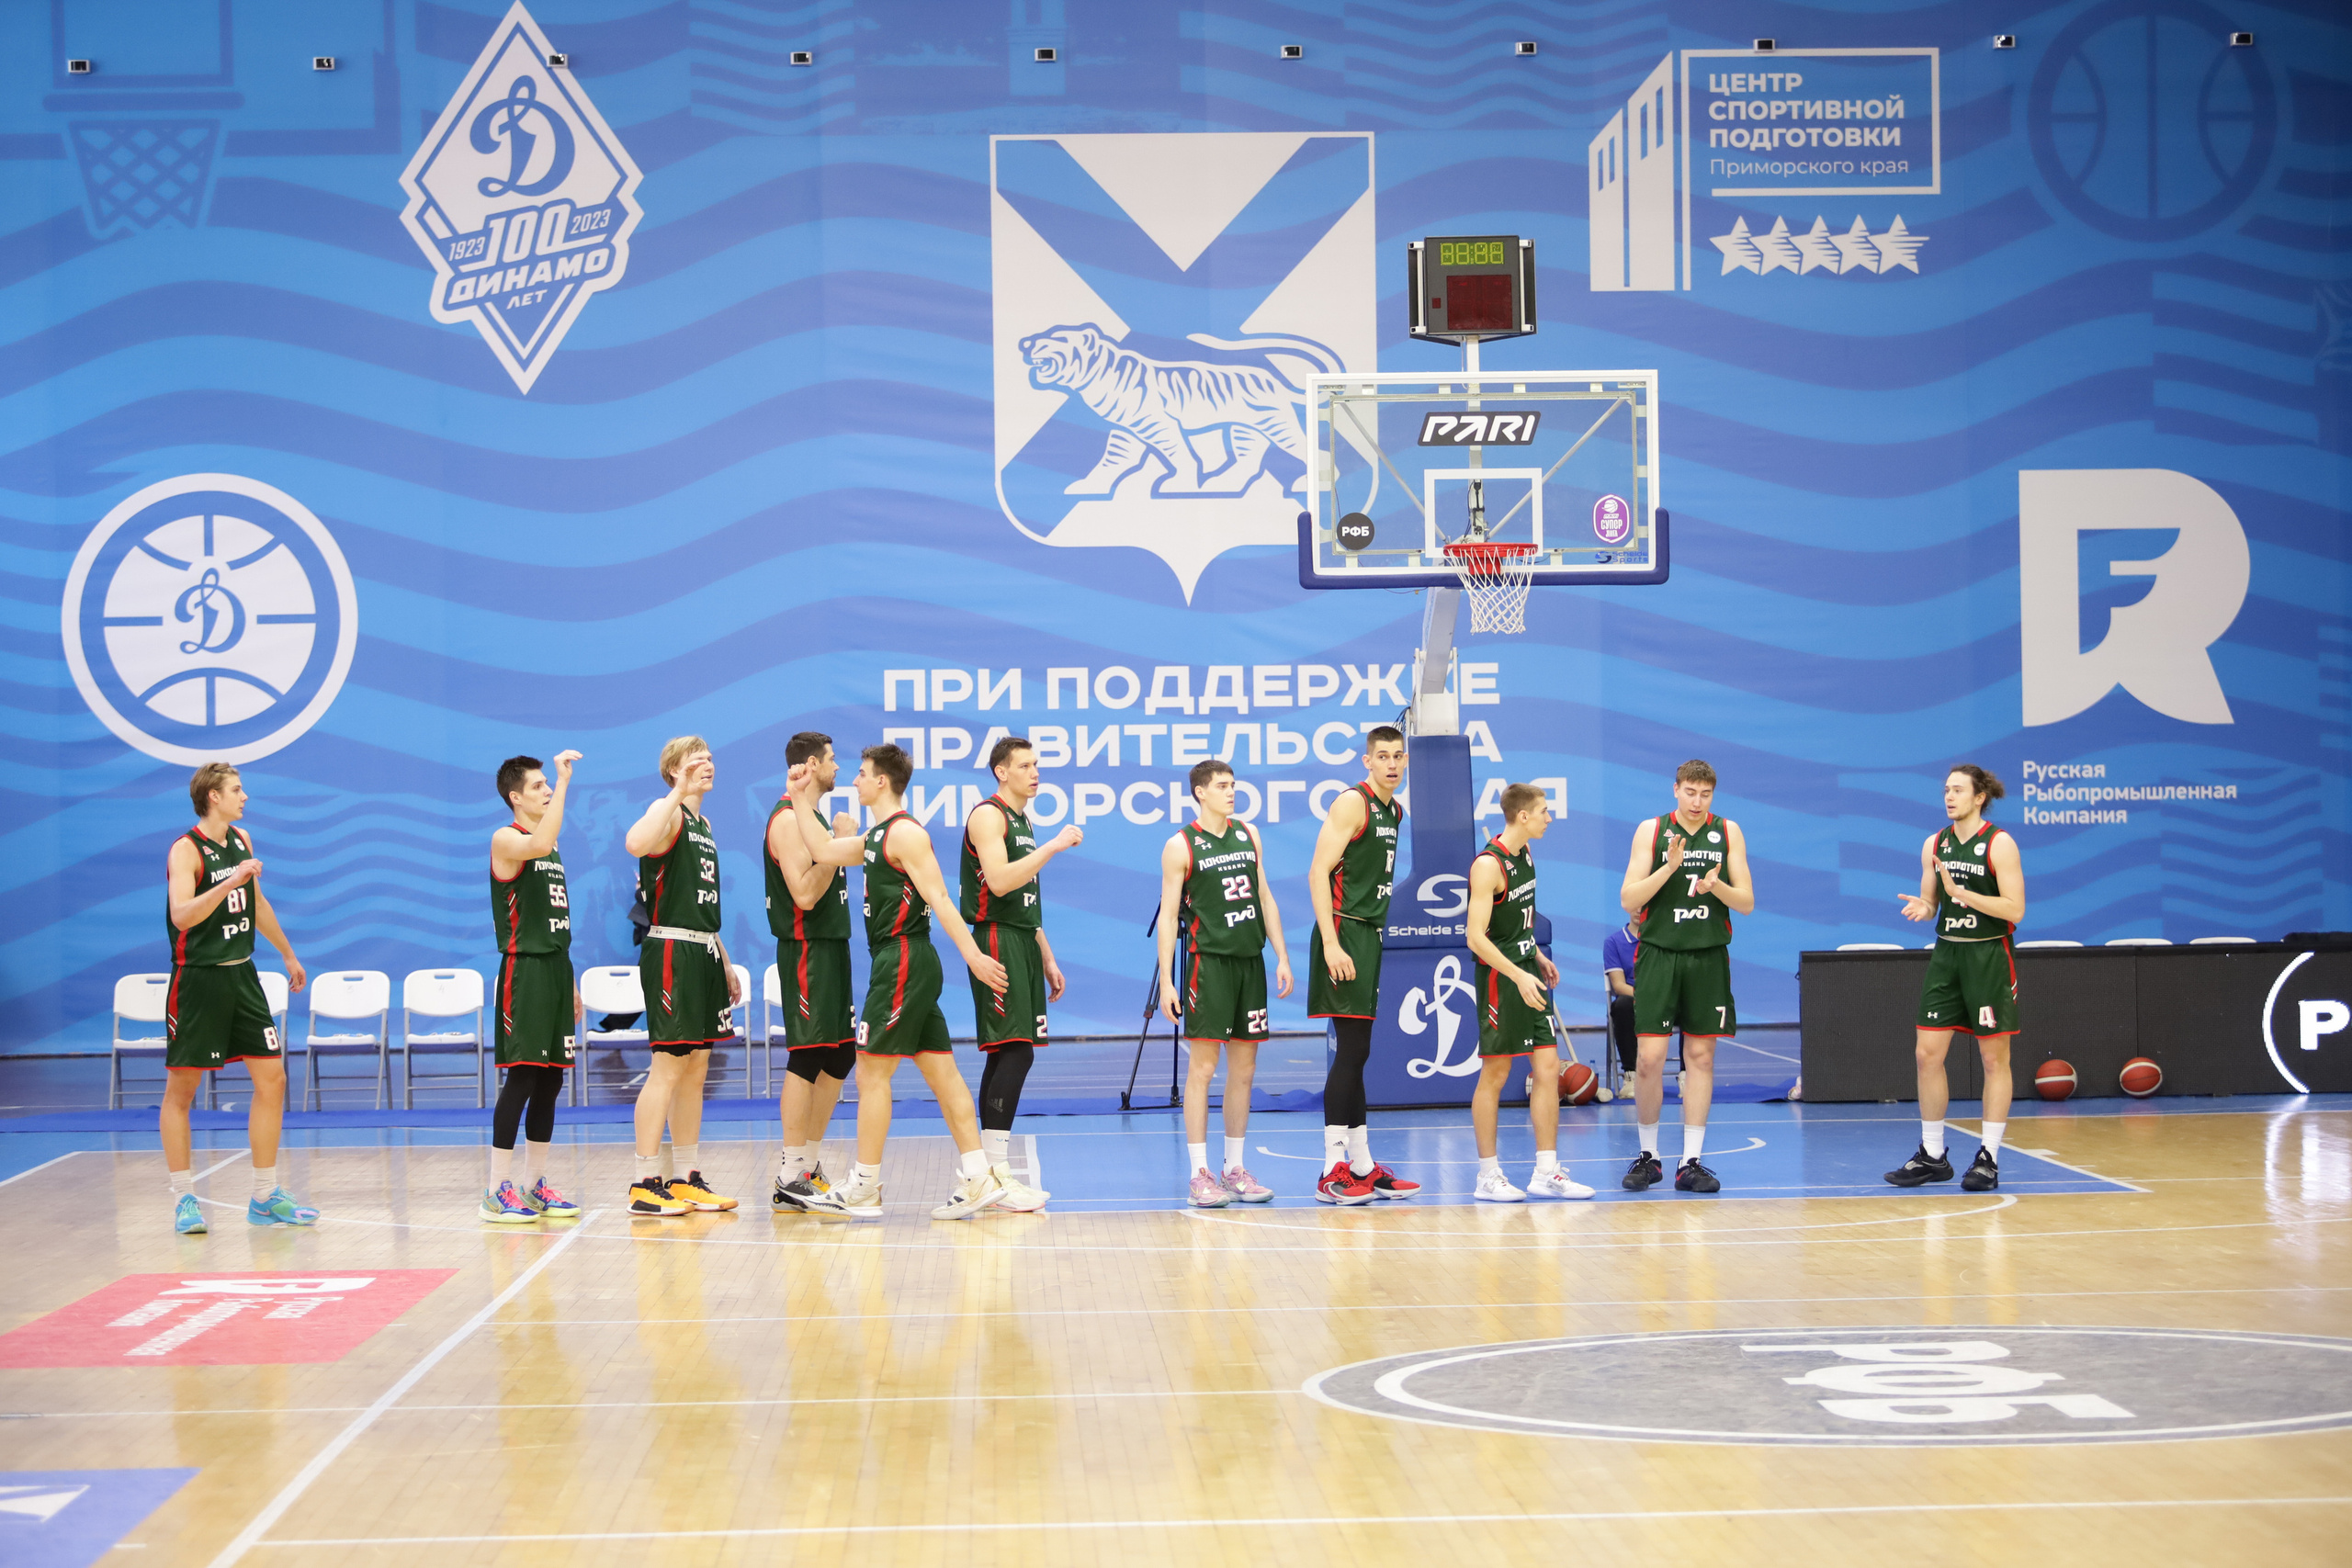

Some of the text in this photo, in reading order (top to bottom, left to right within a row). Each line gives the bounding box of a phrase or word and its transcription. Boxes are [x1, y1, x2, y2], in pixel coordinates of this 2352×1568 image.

[1709, 73, 1803, 96] ЦЕНТР
[1709, 95, 1905, 120] СПОРТИВНОЙ
[1709, 128, 1901, 151] ПОДГОТОВКИ
[1710, 159, 1909, 178] Приморского края
[570, 209, 611, 235] 2023
[473, 203, 588, 270] 100
[448, 236, 486, 262] 1923
[447, 247, 611, 305] ДИНАМО
[506, 289, 548, 310] ЛЕТ
[1422, 414, 1536, 443] PARI
[1341, 525, 1370, 536] РФБ
[883, 662, 1500, 715] ПРИ ПОДДЕРЖЕ
[882, 720, 1503, 770] ПРАВИТЕЛЬСА
[2023, 761, 2106, 783] Русская
[2023, 784, 2238, 805] Рыбопромышленная
[2024, 807, 2128, 825] Компания
[1198, 851, 1256, 872] ЛОКОМОТИВ
[1661, 851, 1723, 863] ЛОМОТИВ
[700, 857, 716, 884] 32
[548, 884, 569, 908] 55
[1222, 874, 1252, 901] 22
[1685, 874, 1700, 897] 7
[228, 887, 247, 914] 81
[1521, 905, 1534, 930] 11
[1388, 924, 1452, 936] Schelde
[1248, 1008, 1268, 1034] 22
[1714, 1006, 1725, 1029] 7
[1978, 1006, 1996, 1028] 4
[1739, 1340, 2137, 1424] РФБ
